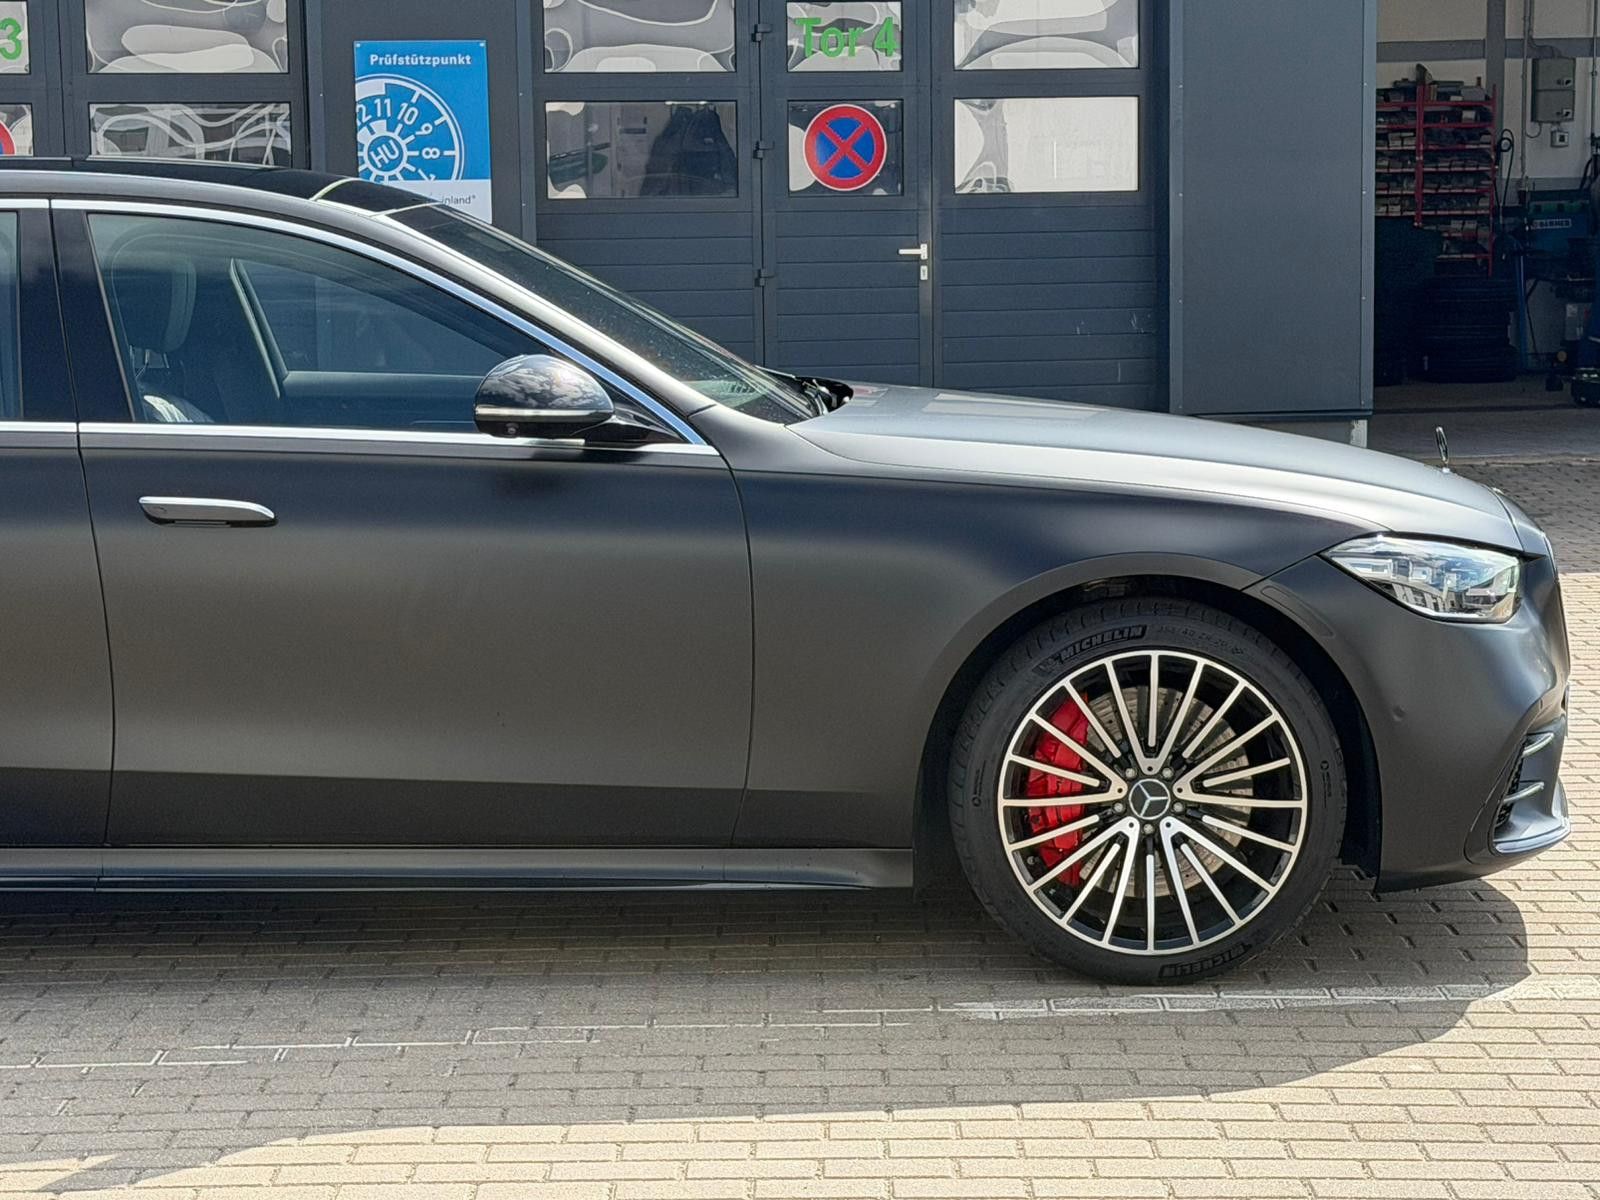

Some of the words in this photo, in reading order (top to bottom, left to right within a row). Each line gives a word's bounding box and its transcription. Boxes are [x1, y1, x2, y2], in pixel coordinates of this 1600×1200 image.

[794, 17, 865, 58] Tor
[873, 16, 898, 58] 4
[369, 53, 472, 68] Prüfstützpunkt
[356, 104, 372, 126] 2
[374, 98, 391, 118] 11
[397, 102, 419, 126] 10
[415, 122, 433, 136] 9
[369, 139, 400, 168] HU
[421, 147, 441, 159] 8
[1059, 625, 1146, 663] MICHELIN
